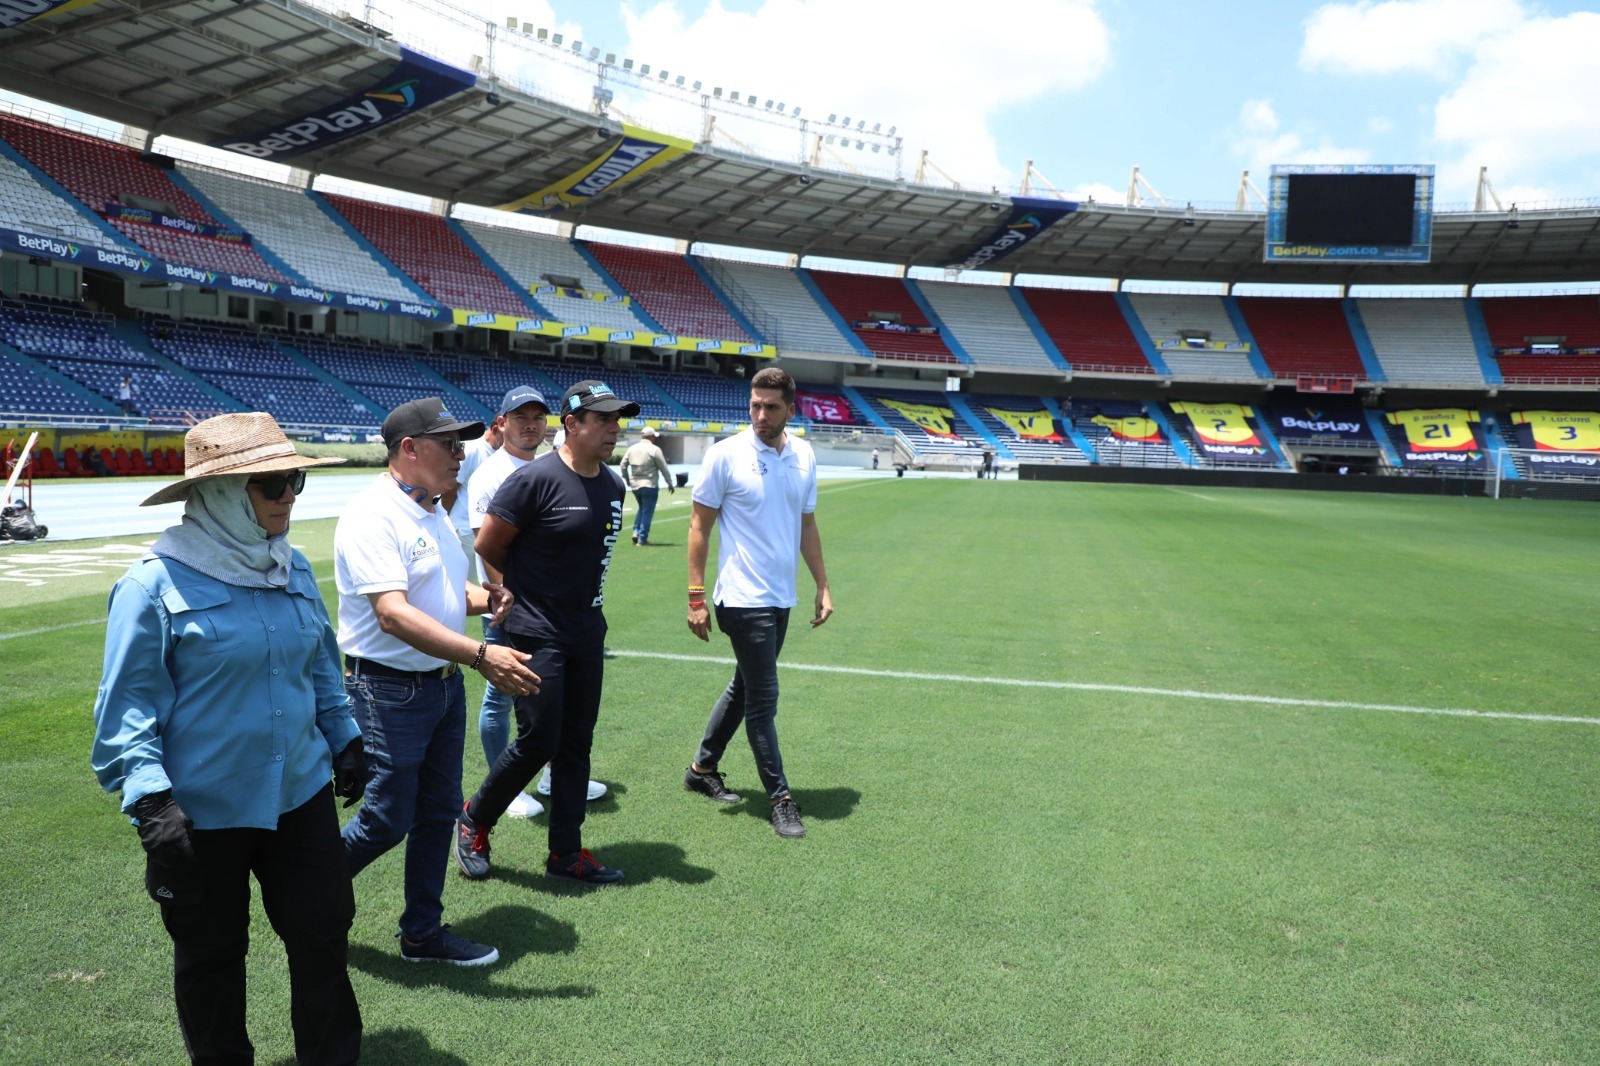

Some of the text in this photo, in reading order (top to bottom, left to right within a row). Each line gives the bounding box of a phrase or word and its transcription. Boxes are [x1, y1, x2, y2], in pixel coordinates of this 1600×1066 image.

[223, 99, 383, 158] BetPlay
[574, 144, 664, 196] AGUILA
[162, 216, 197, 233] BetPlay
[18, 235, 68, 257] BetPlay
[1273, 246, 1378, 257] BetPlay.com.co
[98, 251, 141, 271] BetPlay
[166, 264, 207, 283] BetPlay
[231, 275, 269, 292] BetPlay
[290, 285, 325, 302] BetPlay
[346, 295, 381, 310] BetPlay
[400, 303, 432, 318] BetPlay
[1281, 416, 1360, 433] BetPlay
[1422, 423, 1452, 439] 21
[1557, 425, 1578, 441] 3
[1406, 452, 1467, 462] BetPlay
[1530, 454, 1597, 465] BetPlay
